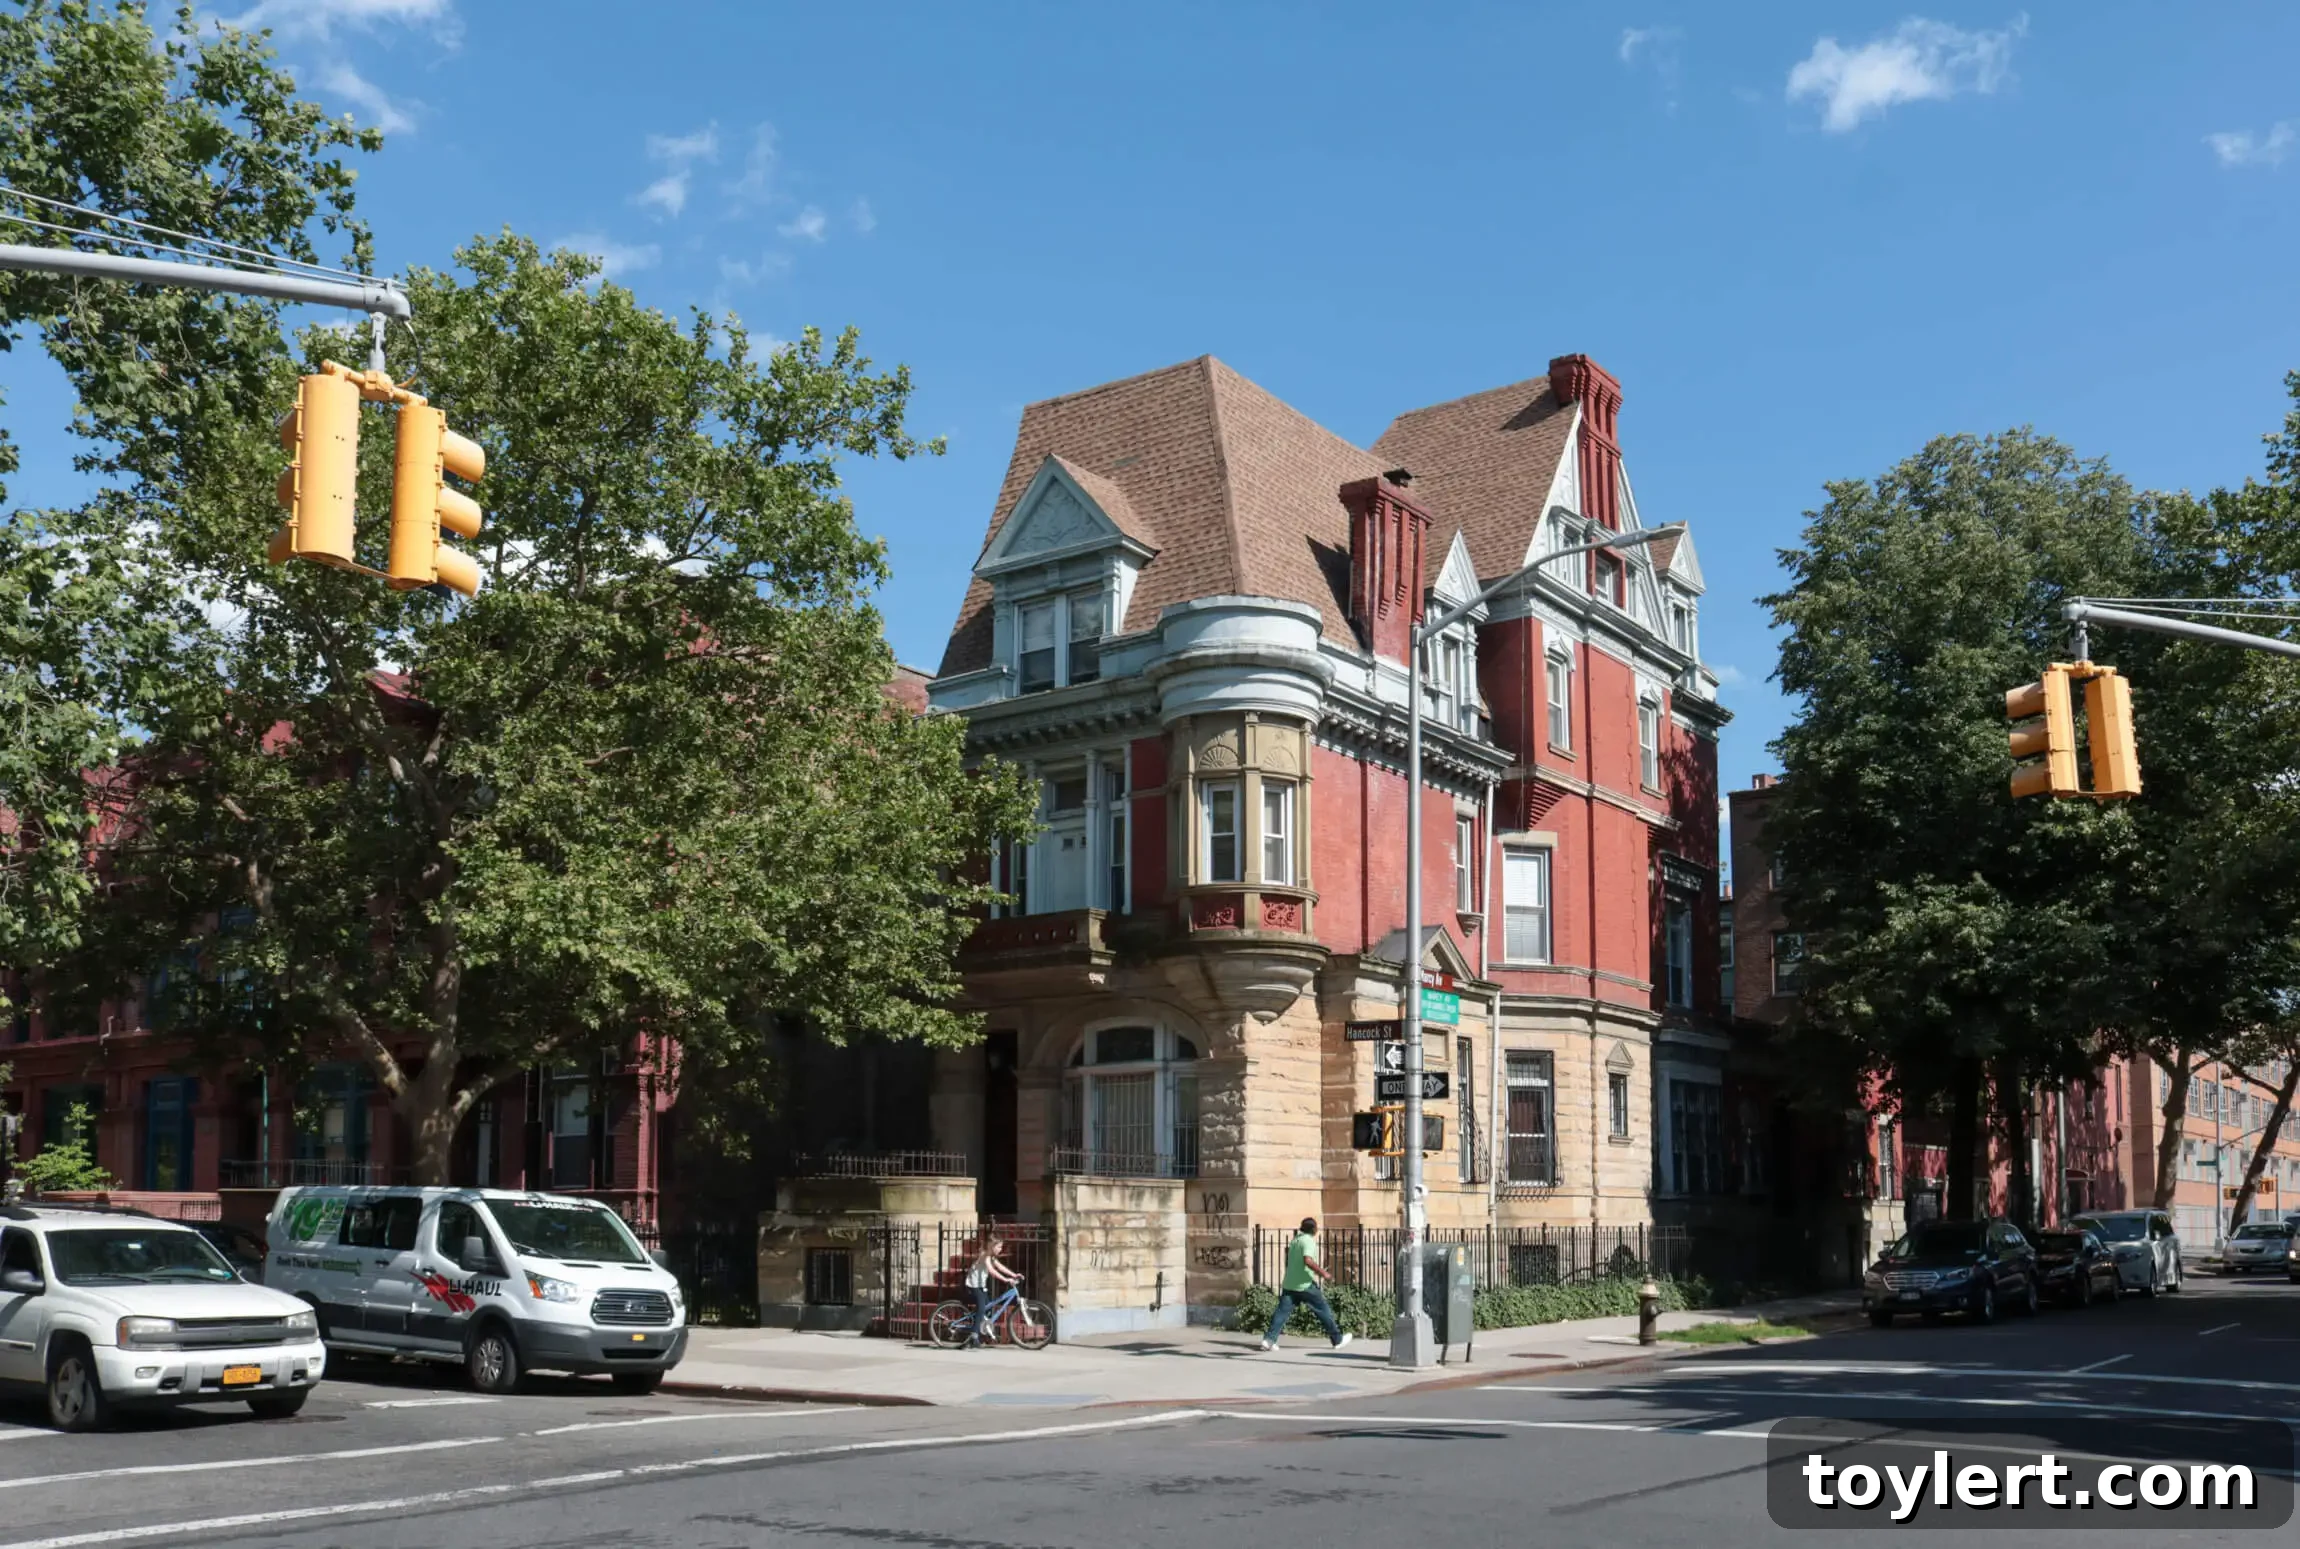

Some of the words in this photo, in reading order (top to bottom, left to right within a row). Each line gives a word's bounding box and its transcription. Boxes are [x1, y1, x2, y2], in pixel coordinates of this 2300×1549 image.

[1346, 1026, 1380, 1040] Hancock
[1383, 1024, 1392, 1038] St
[448, 1278, 502, 1296] U-HAUL
